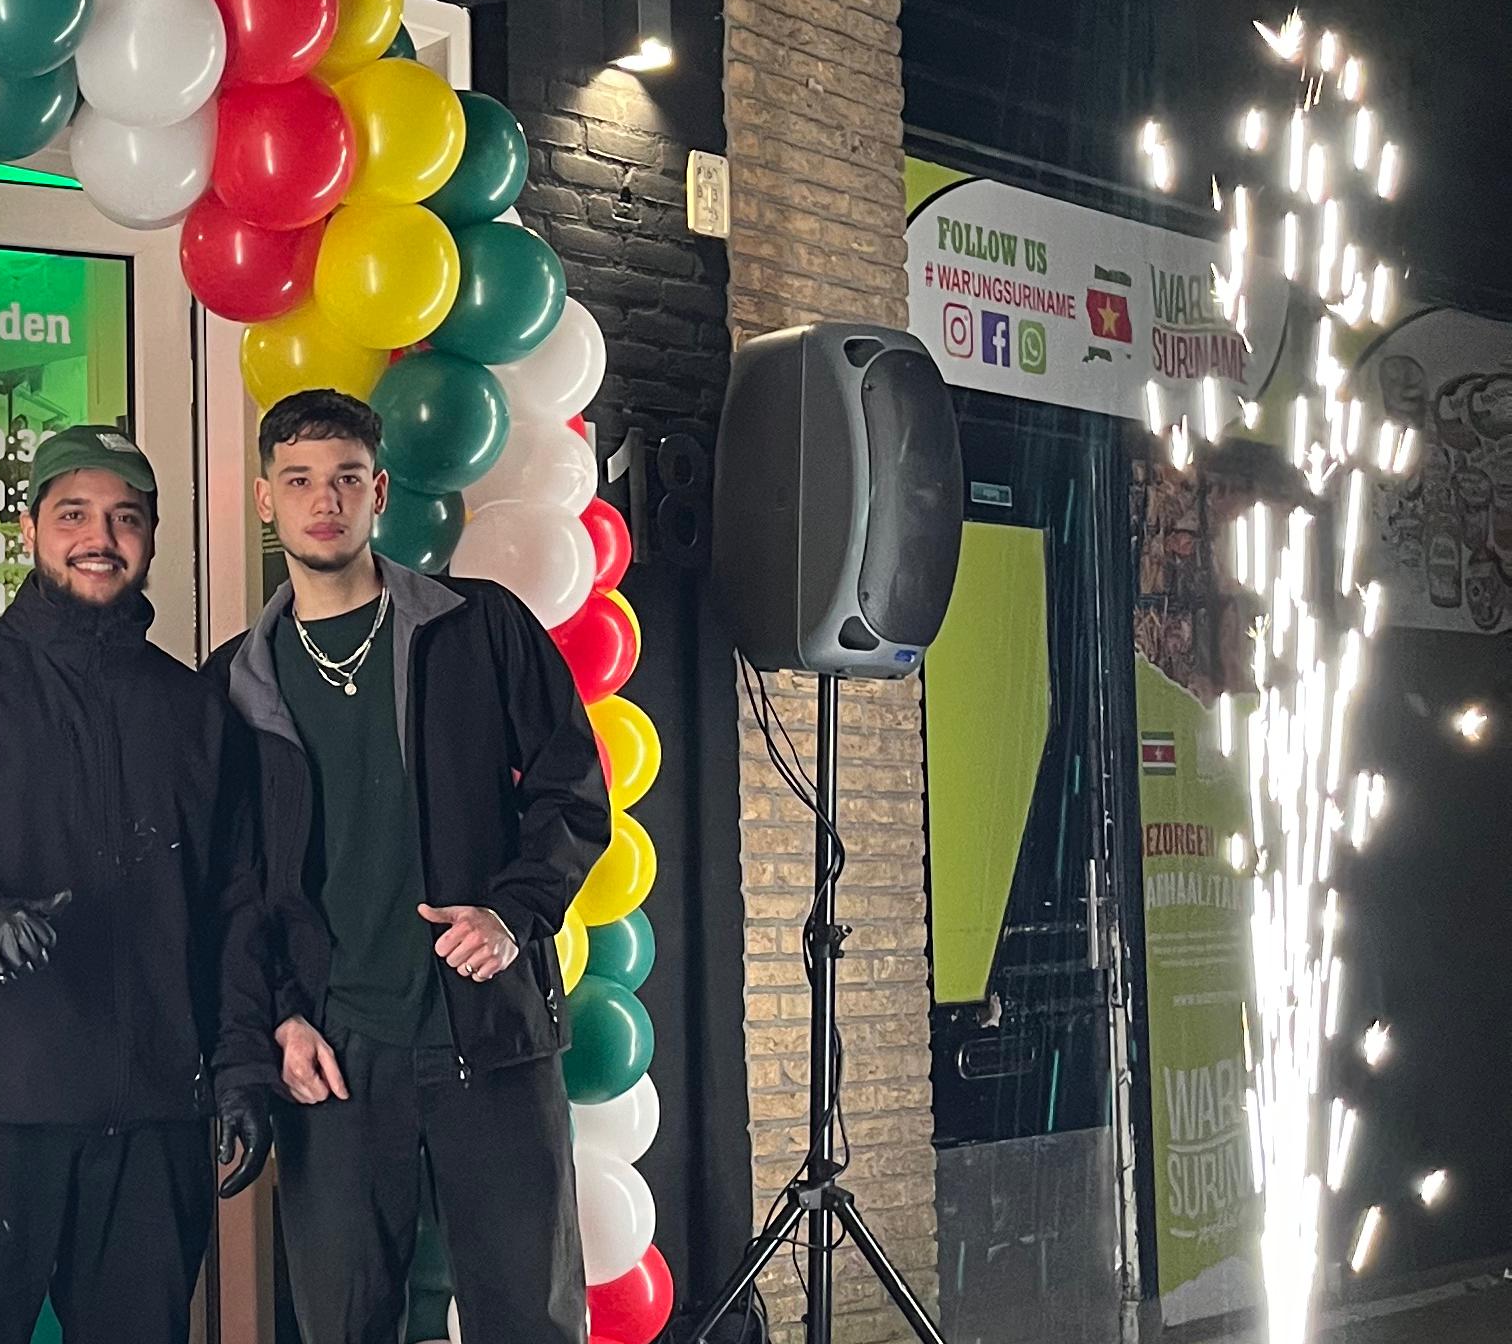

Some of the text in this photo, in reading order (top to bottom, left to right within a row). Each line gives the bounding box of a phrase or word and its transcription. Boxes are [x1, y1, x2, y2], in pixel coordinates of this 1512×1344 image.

[937, 216, 1048, 275] FOLLOW US
[586, 420, 712, 564] 18
